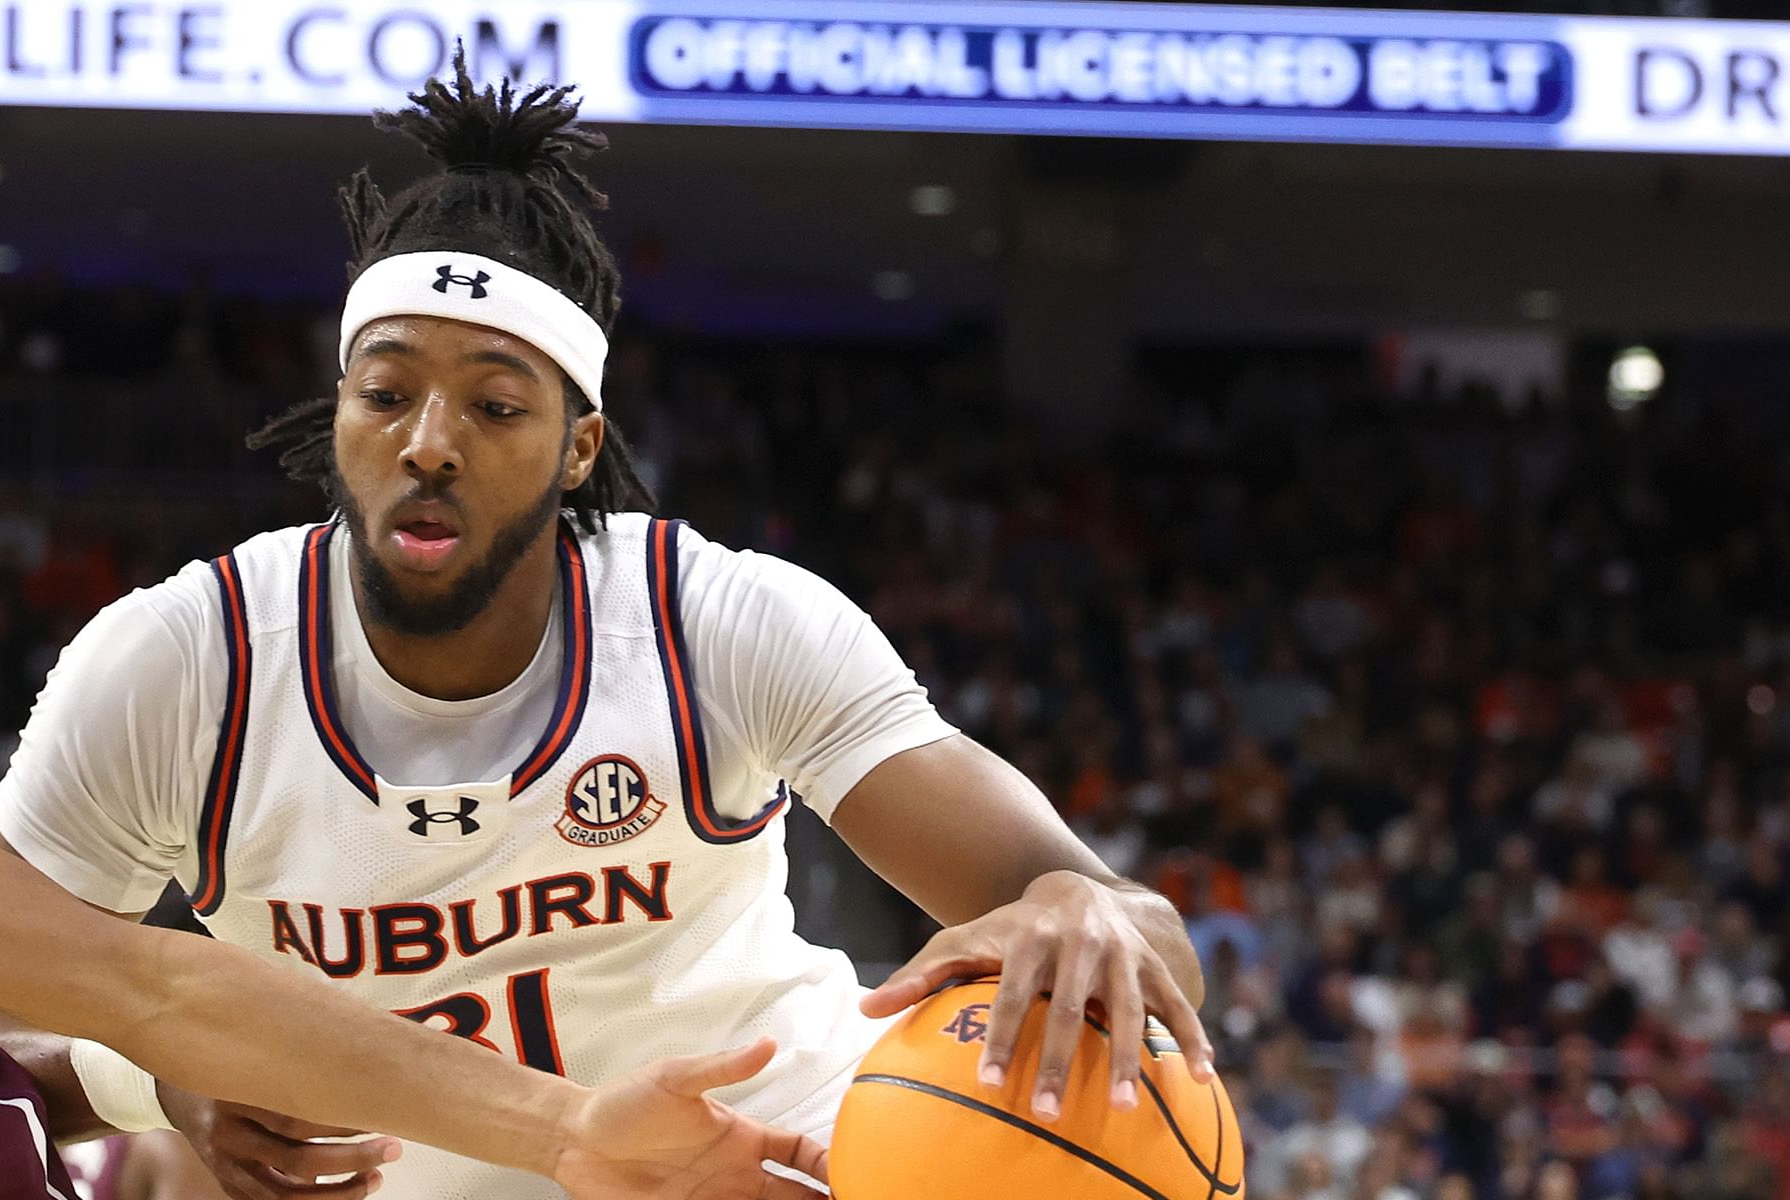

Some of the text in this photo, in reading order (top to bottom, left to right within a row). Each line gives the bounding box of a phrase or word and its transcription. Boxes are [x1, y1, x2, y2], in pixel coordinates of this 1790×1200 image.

[644, 17, 1553, 113] OFFICIAL LICENSED BELT
[1635, 47, 1782, 122] DR
[568, 813, 652, 844] GRADUATE
[572, 761, 642, 824] SEC
[266, 861, 674, 980] AUBURN
